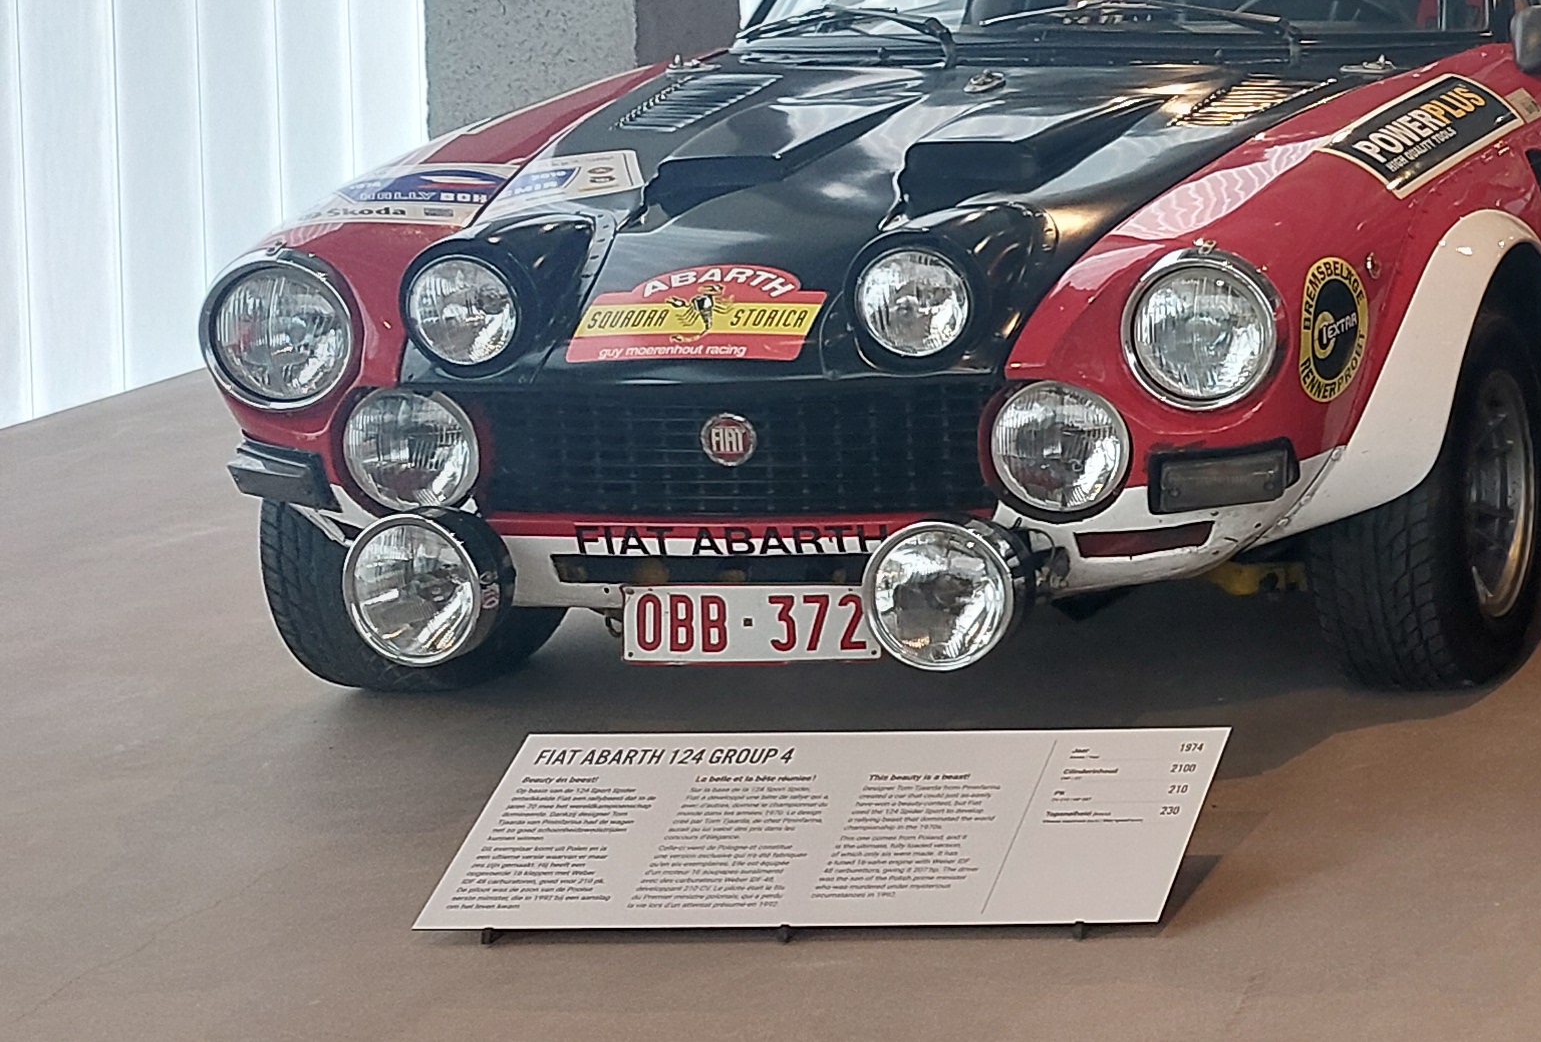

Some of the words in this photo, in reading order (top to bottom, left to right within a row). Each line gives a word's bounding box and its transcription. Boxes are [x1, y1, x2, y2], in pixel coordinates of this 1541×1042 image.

[1352, 87, 1487, 164] POWERPLUS
[643, 267, 795, 298] ABARTH
[705, 344, 747, 358] racing
[711, 427, 746, 453] FIAT
[575, 525, 674, 555] FIAT
[1180, 743, 1204, 752] 1974
[534, 749, 583, 765] FIAT
[580, 749, 665, 765] ABARTH
[669, 748, 706, 765] 124
[709, 748, 778, 764] GROUP
[780, 748, 795, 764] 4
[1170, 764, 1197, 773] 2100
[1168, 785, 1188, 794] 210
[1160, 806, 1181, 815] 230
